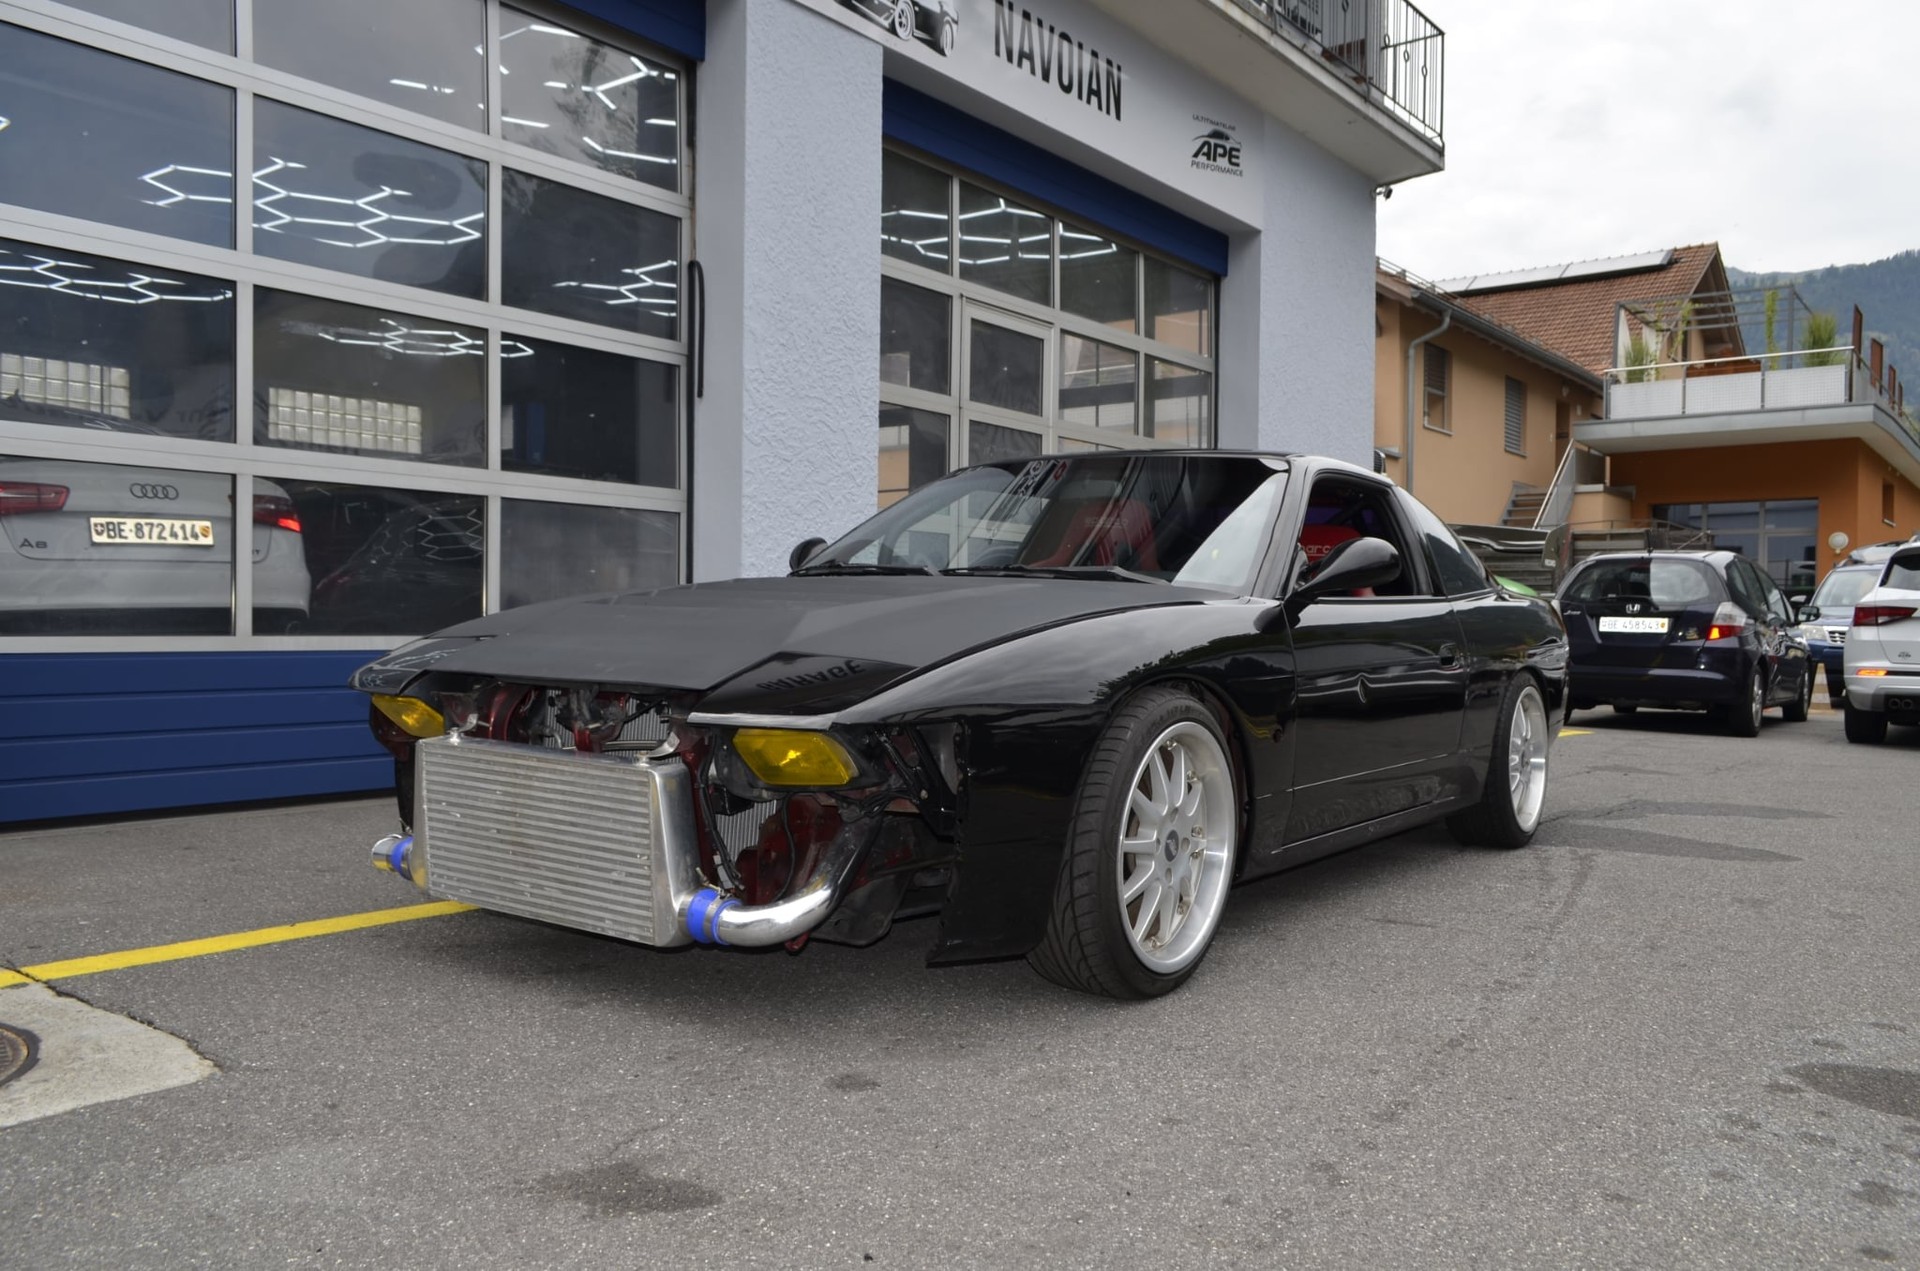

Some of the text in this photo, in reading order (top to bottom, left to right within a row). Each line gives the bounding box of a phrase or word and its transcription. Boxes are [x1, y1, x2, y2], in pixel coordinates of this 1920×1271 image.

[994, 0, 1122, 121] NAVOIAN
[1192, 140, 1241, 167] APE
[1190, 159, 1243, 177] PERFORMANCE
